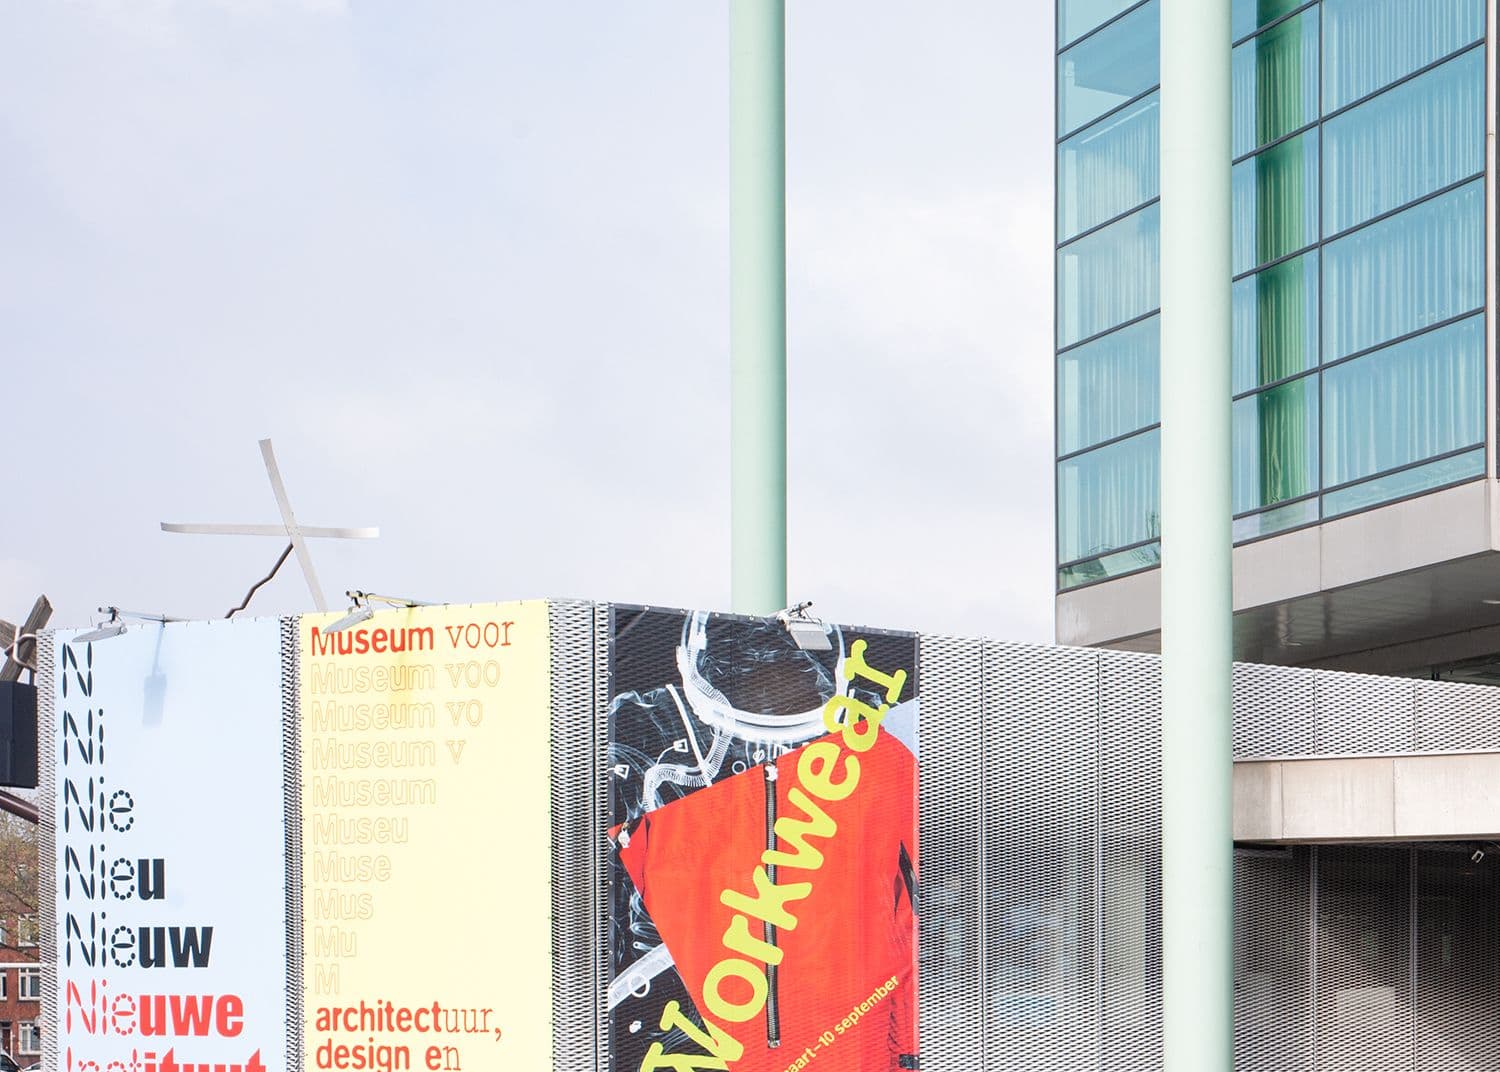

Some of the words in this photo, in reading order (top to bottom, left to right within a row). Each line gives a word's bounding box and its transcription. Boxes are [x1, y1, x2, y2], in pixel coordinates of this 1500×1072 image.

[311, 627, 434, 656] Museum
[445, 620, 514, 649] voor
[62, 641, 93, 699] N
[311, 662, 435, 695] Museum
[445, 660, 500, 689] voo
[311, 700, 435, 732] Museum
[446, 699, 483, 727] vo
[63, 708, 104, 766] Ni
[312, 738, 436, 770] Museum
[64, 776, 134, 833] Nie
[313, 775, 436, 807] Museum
[313, 813, 409, 845] Museu
[65, 843, 165, 900] Nieu
[313, 850, 392, 882] Muse
[314, 888, 374, 920] Mus
[66, 911, 214, 968] Nieuw
[314, 925, 357, 957] Mu
[314, 963, 340, 995] M
[67, 978, 244, 1037] Nieuwe
[315, 1000, 502, 1041] architectuur,
[834, 975, 900, 1036] september
[425, 1045, 462, 1071] en
